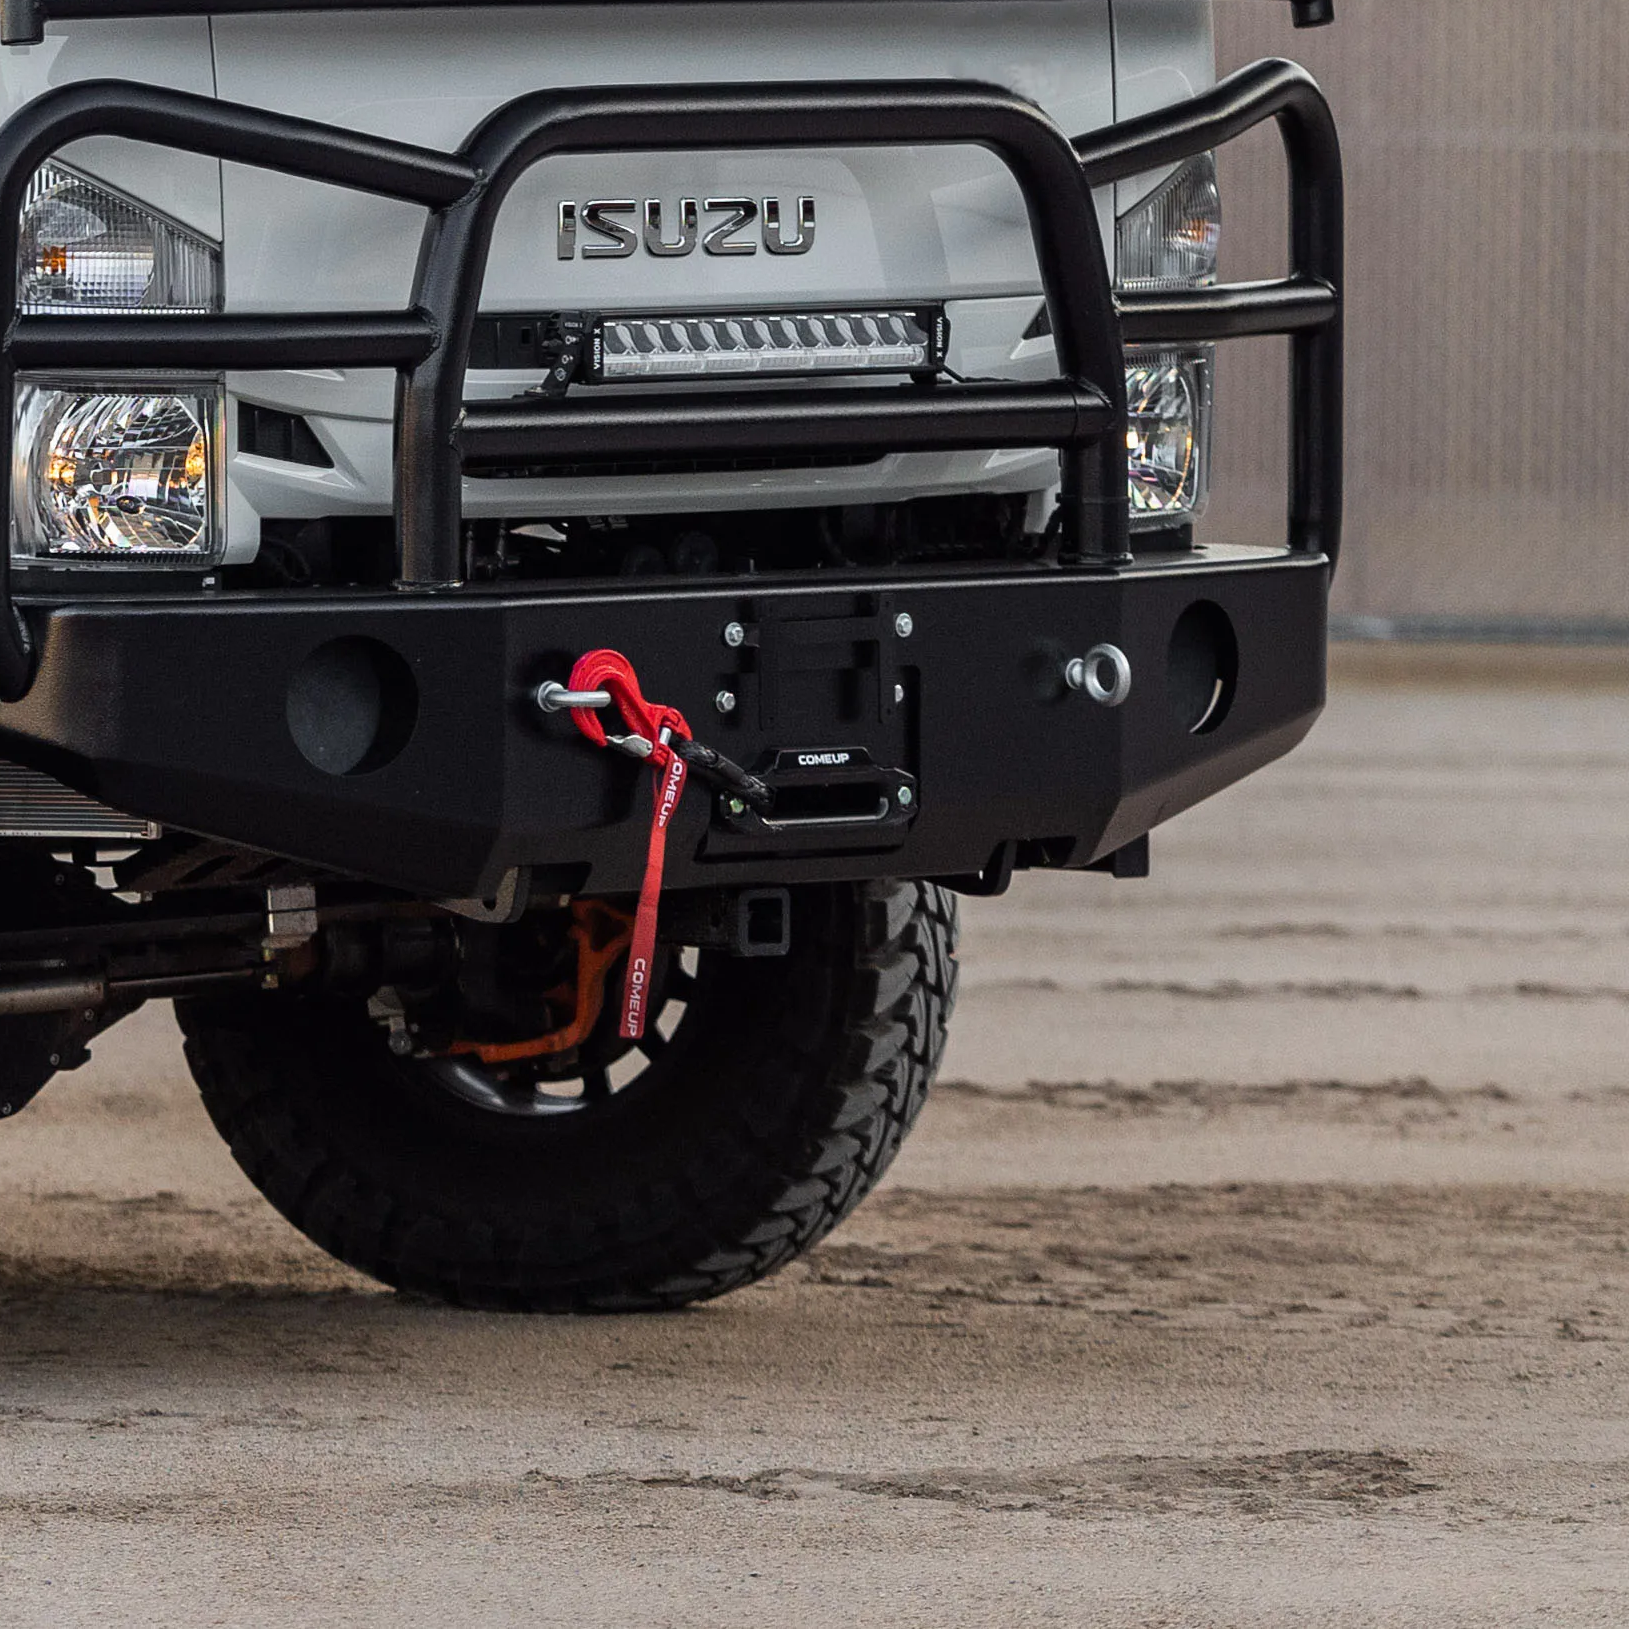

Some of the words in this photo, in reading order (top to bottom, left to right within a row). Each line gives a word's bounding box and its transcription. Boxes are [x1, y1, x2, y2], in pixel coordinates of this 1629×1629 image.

[557, 196, 816, 260] ISUZU
[593, 338, 601, 370] VISION
[798, 752, 849, 766] COMEUP
[626, 957, 646, 1037] COMEUP
